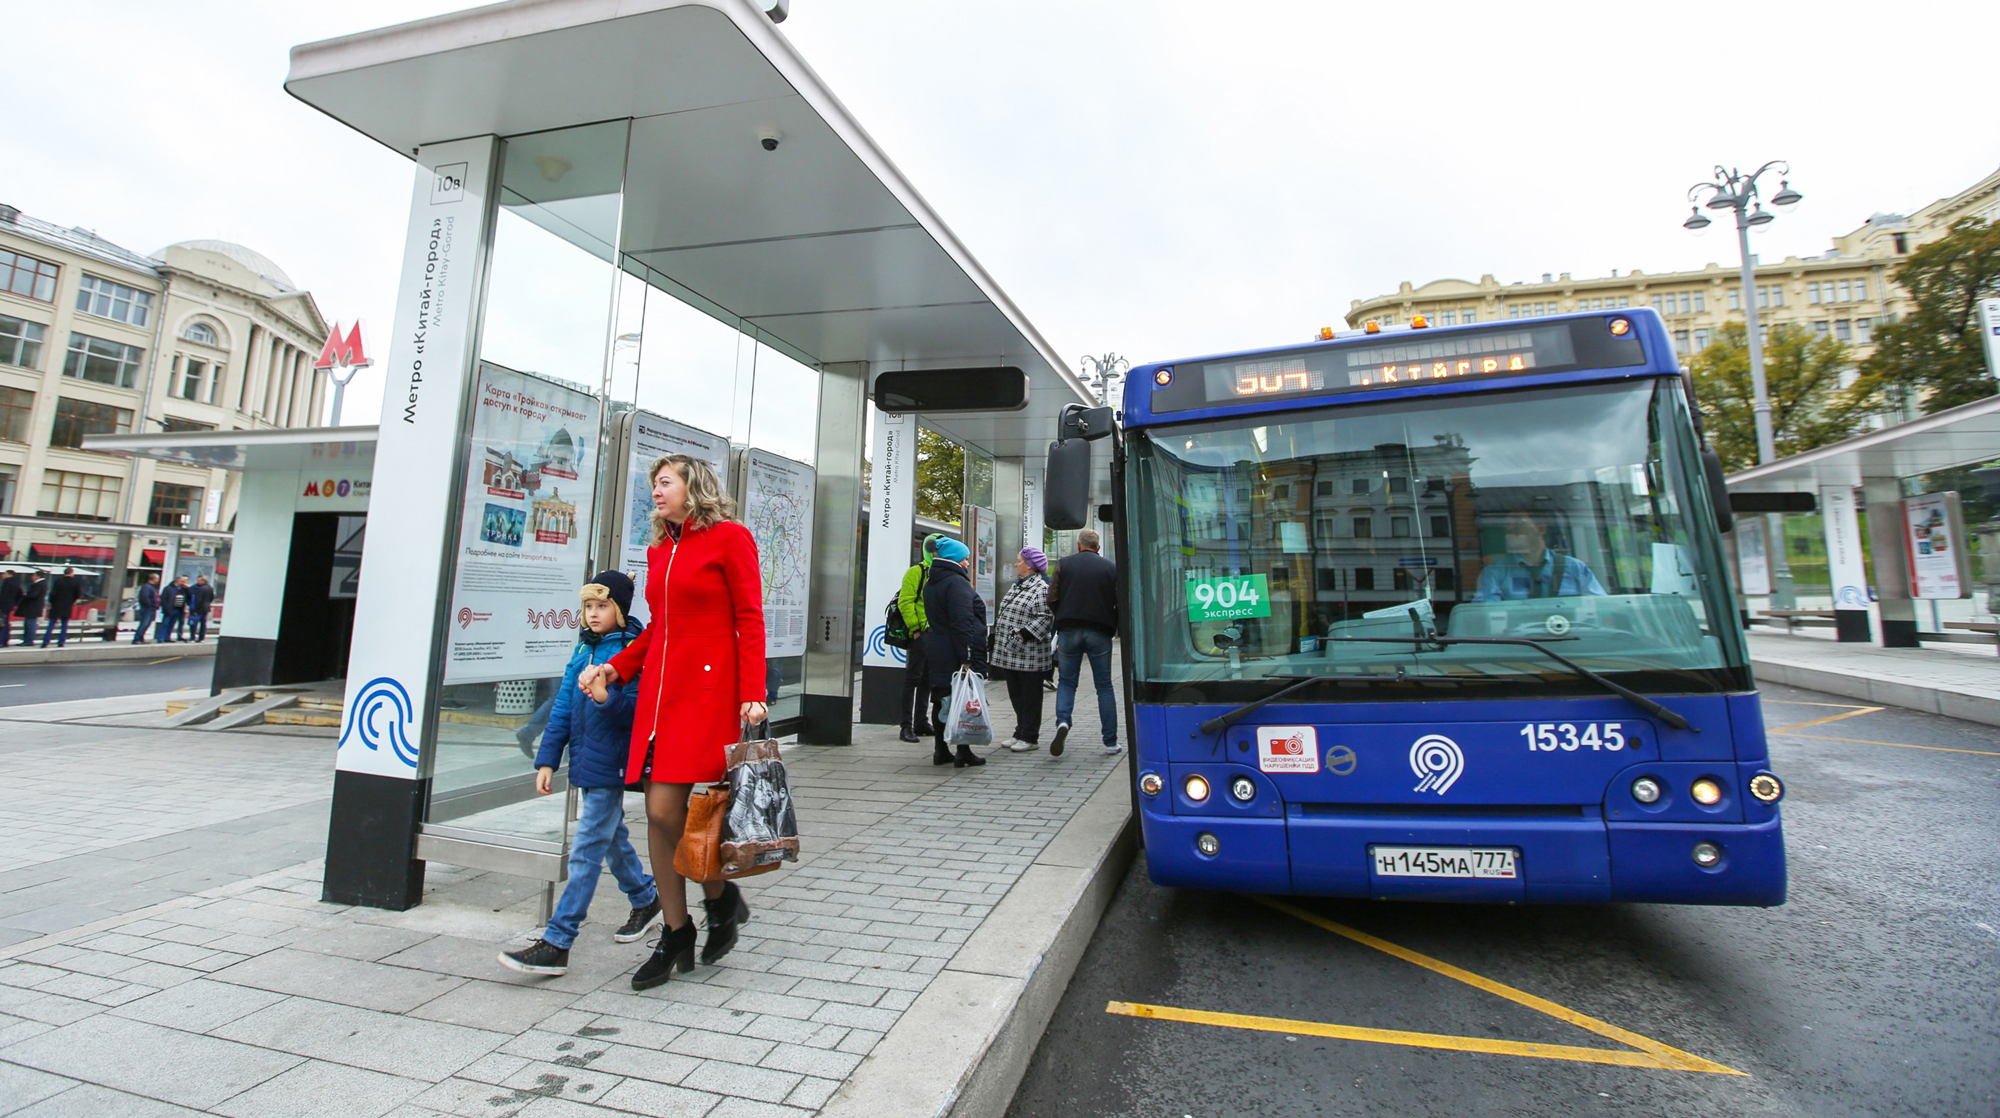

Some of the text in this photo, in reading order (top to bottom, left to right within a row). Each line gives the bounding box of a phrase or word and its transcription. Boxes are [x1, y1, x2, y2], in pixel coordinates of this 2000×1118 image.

[432, 216, 455, 327] Metro Kitay-Gorod
[402, 218, 442, 424] Метро «Китай-город»
[483, 397, 512, 412] доступ
[520, 408, 547, 423] городу
[485, 383, 587, 421] Карта «Тройка» открывает
[882, 430, 894, 528] Метро «Китай-город»
[465, 547, 497, 558] Подробнее
[1194, 580, 1260, 610] 904
[1204, 607, 1253, 619] экспресс
[1520, 723, 1625, 752] 15345
[1383, 852, 1507, 874] Н145МА 777
[1483, 868, 1501, 876] RUS
